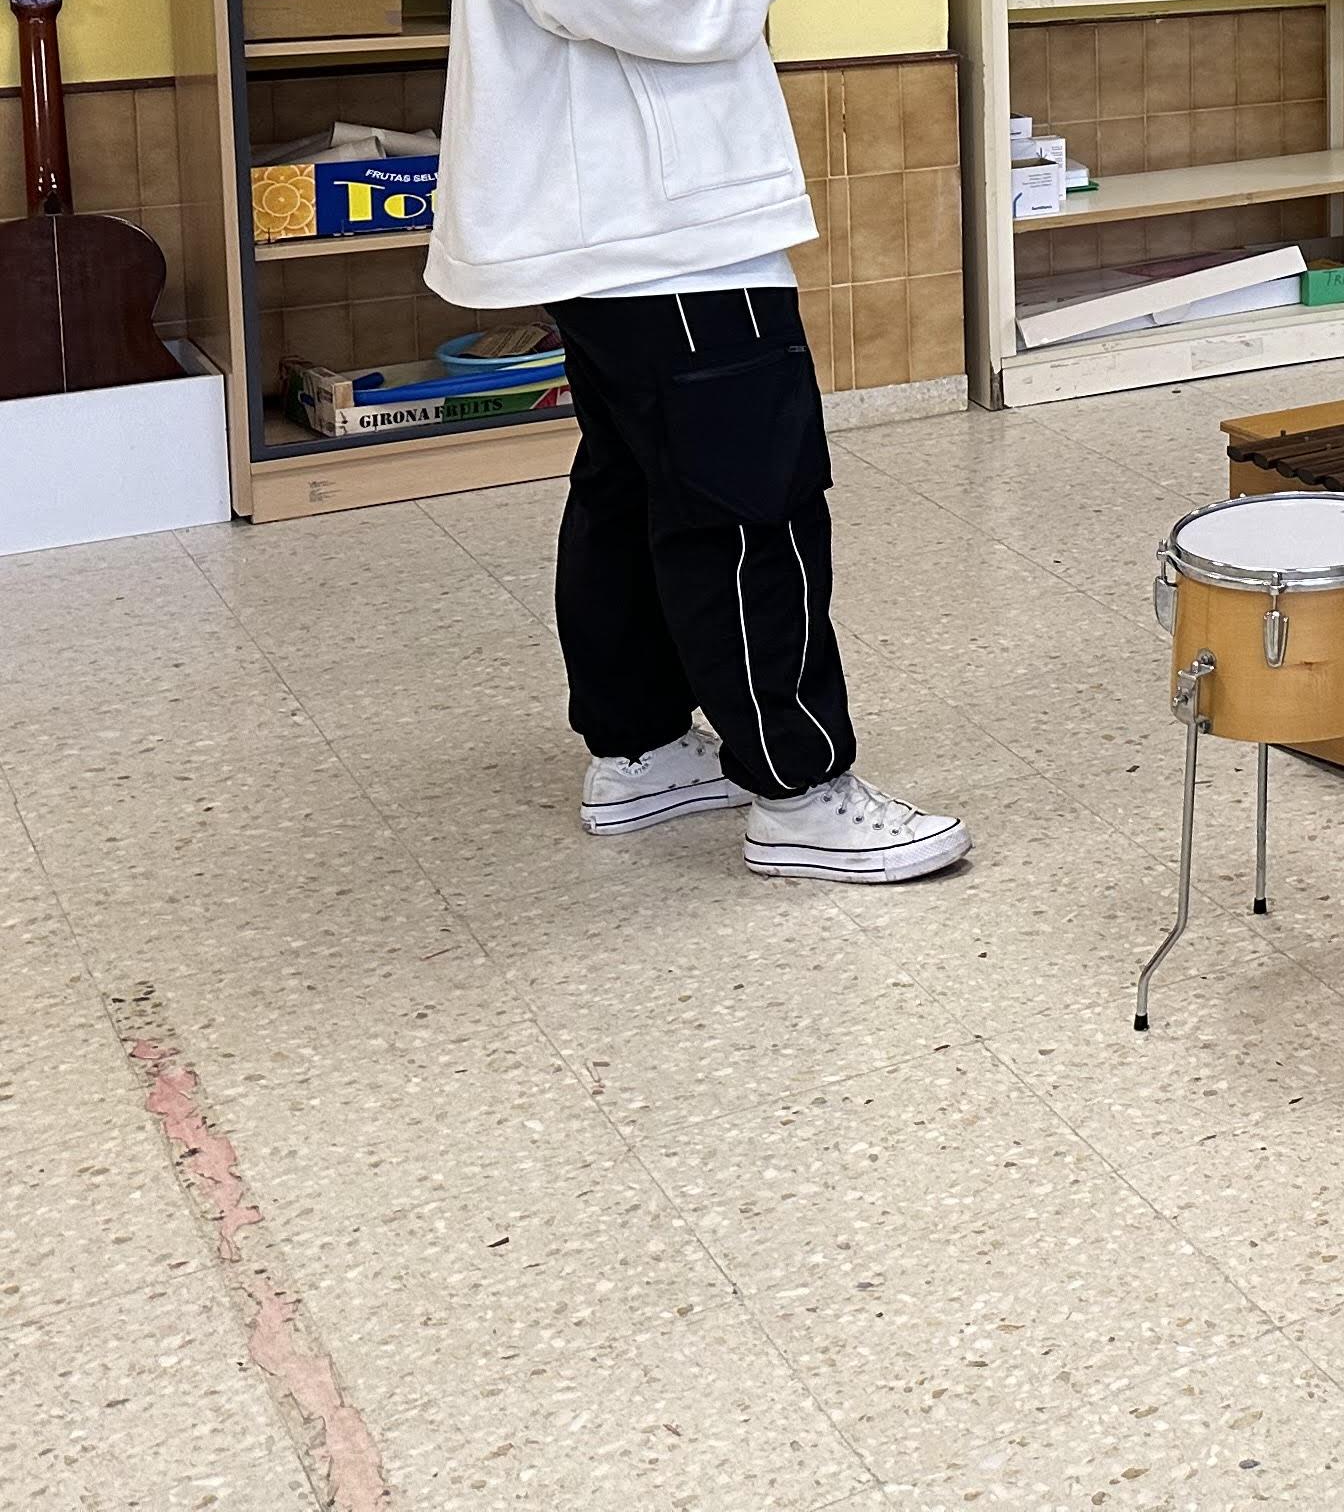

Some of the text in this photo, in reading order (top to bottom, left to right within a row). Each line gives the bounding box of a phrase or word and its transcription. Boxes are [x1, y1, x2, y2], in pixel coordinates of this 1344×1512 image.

[365, 168, 411, 183] FRUTAS
[359, 397, 503, 429] GIRONA FRUITS
